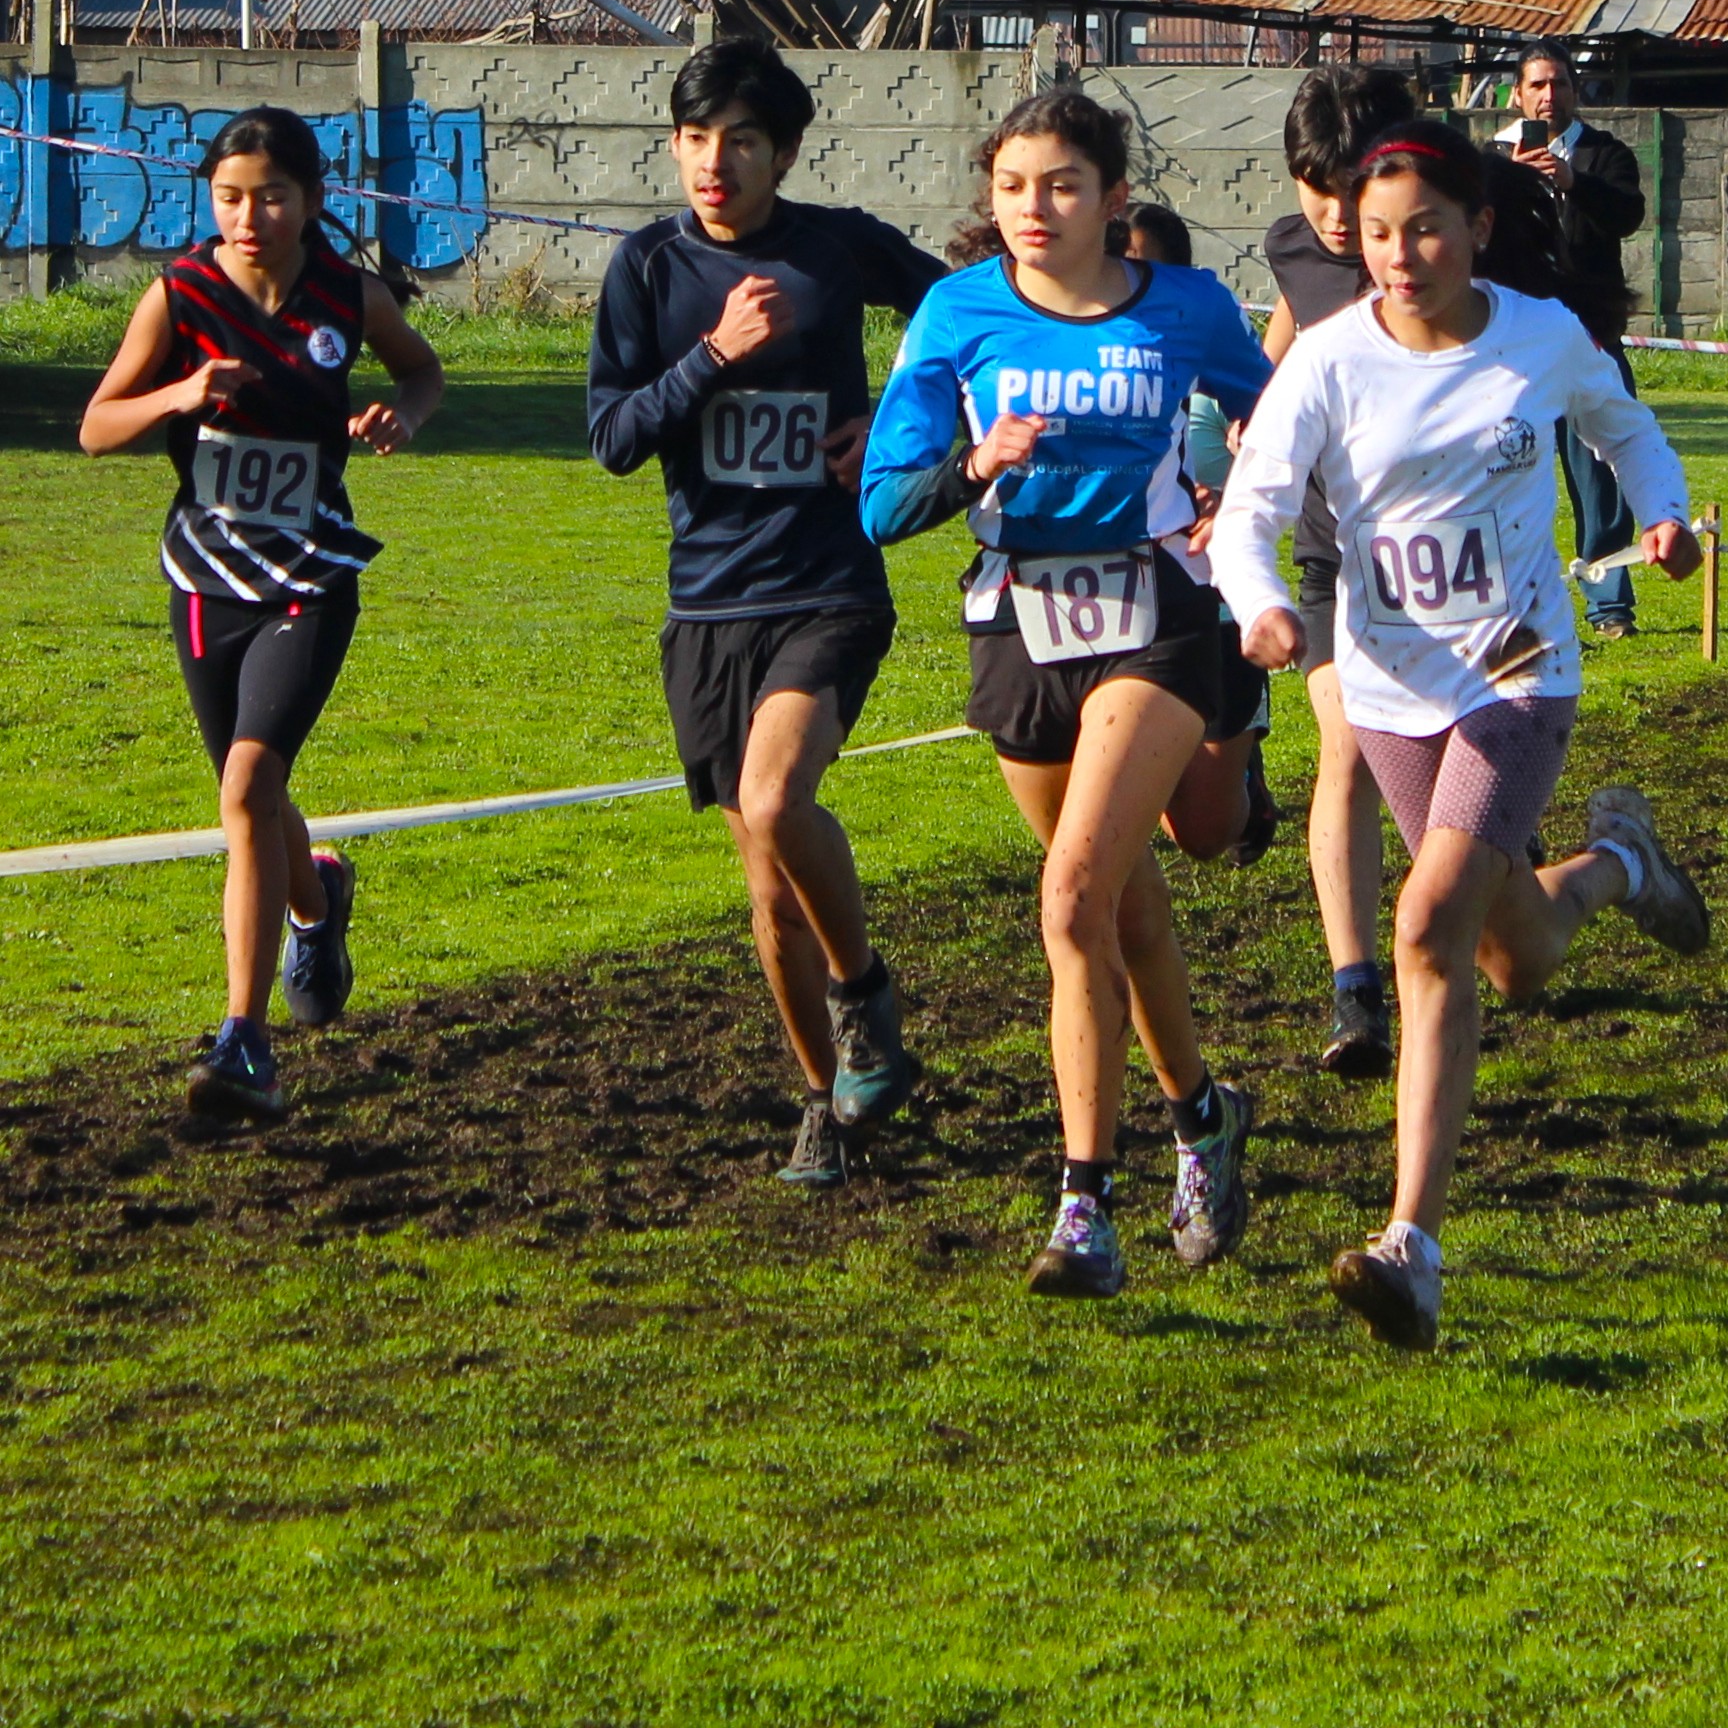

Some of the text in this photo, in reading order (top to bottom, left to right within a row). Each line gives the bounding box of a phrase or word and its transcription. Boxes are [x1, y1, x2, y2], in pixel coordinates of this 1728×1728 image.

[1097, 344, 1163, 371] TEAM
[714, 402, 817, 473] 026
[211, 445, 308, 518] 192
[1032, 560, 1141, 648] 187
[1369, 527, 1494, 612] 094
